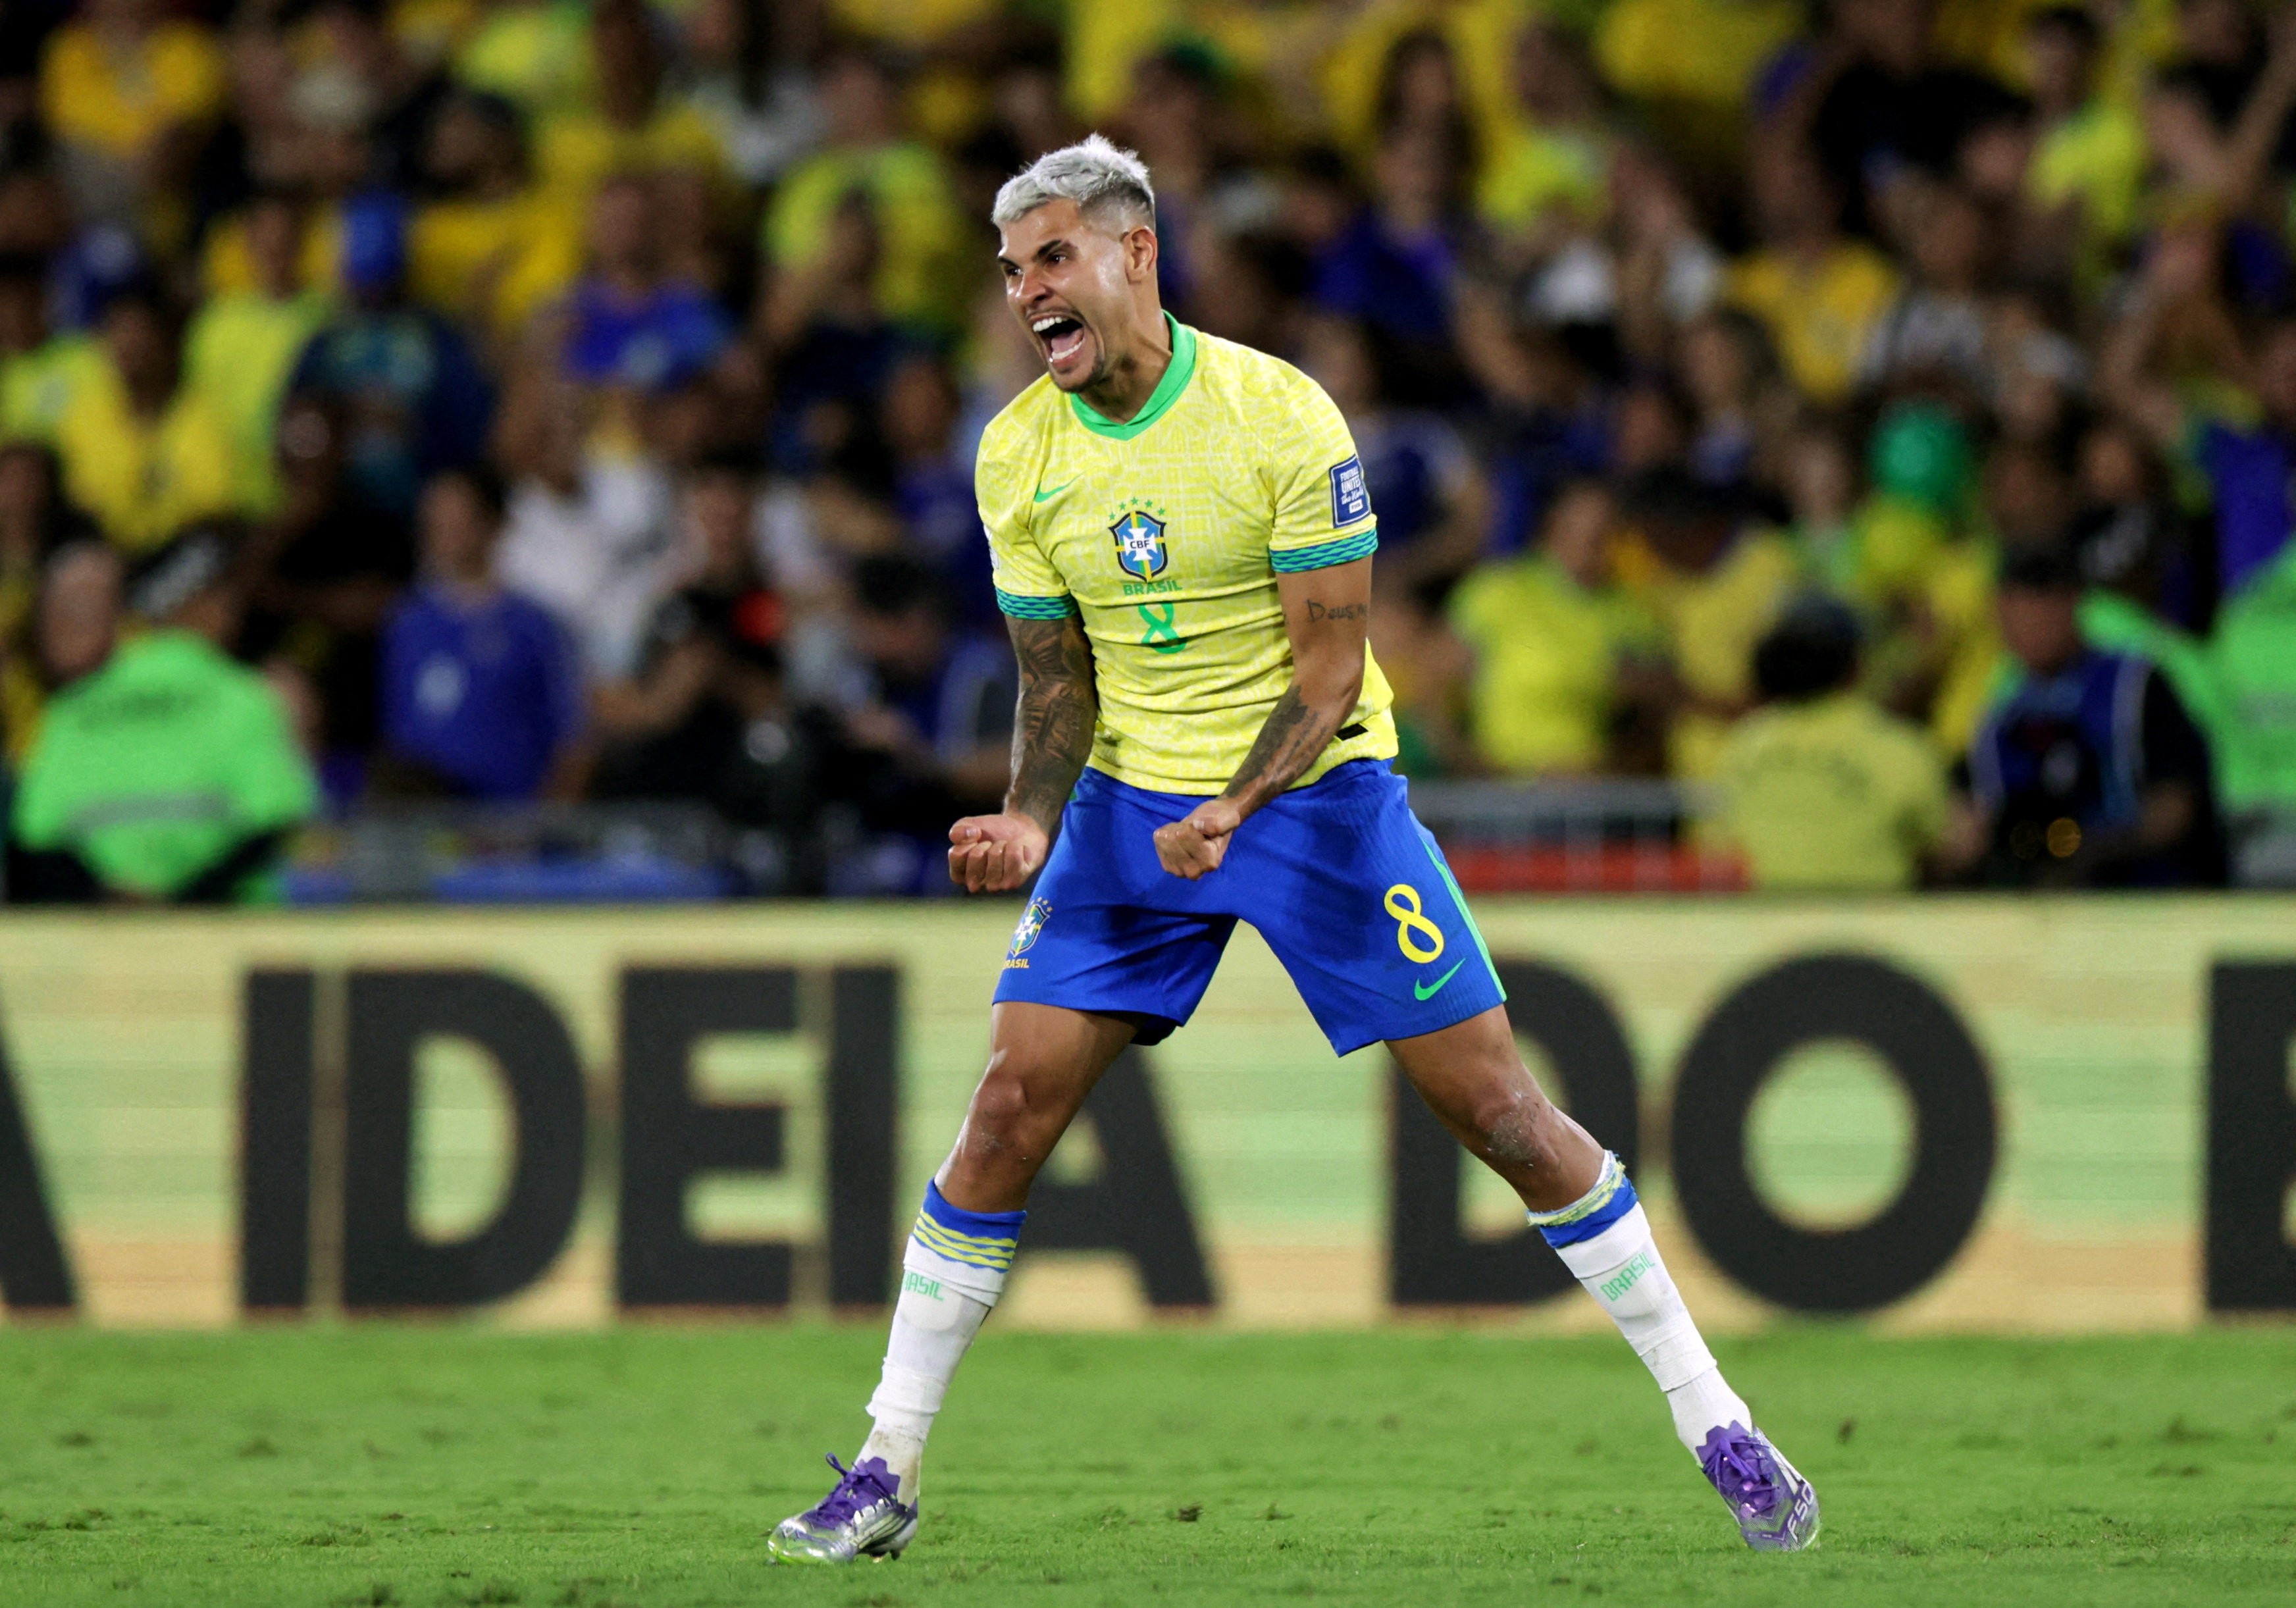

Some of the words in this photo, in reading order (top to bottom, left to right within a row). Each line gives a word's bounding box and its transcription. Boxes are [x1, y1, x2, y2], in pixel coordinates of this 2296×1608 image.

[1130, 539, 1150, 549] CBF
[1122, 579, 1183, 596] BRASIL
[1137, 600, 1187, 654] 8
[1384, 883, 1444, 964] 8
[1003, 958, 1030, 969] RASIL
[1390, 952, 1998, 1312] DO
[1600, 1252, 1656, 1302] BRASIL
